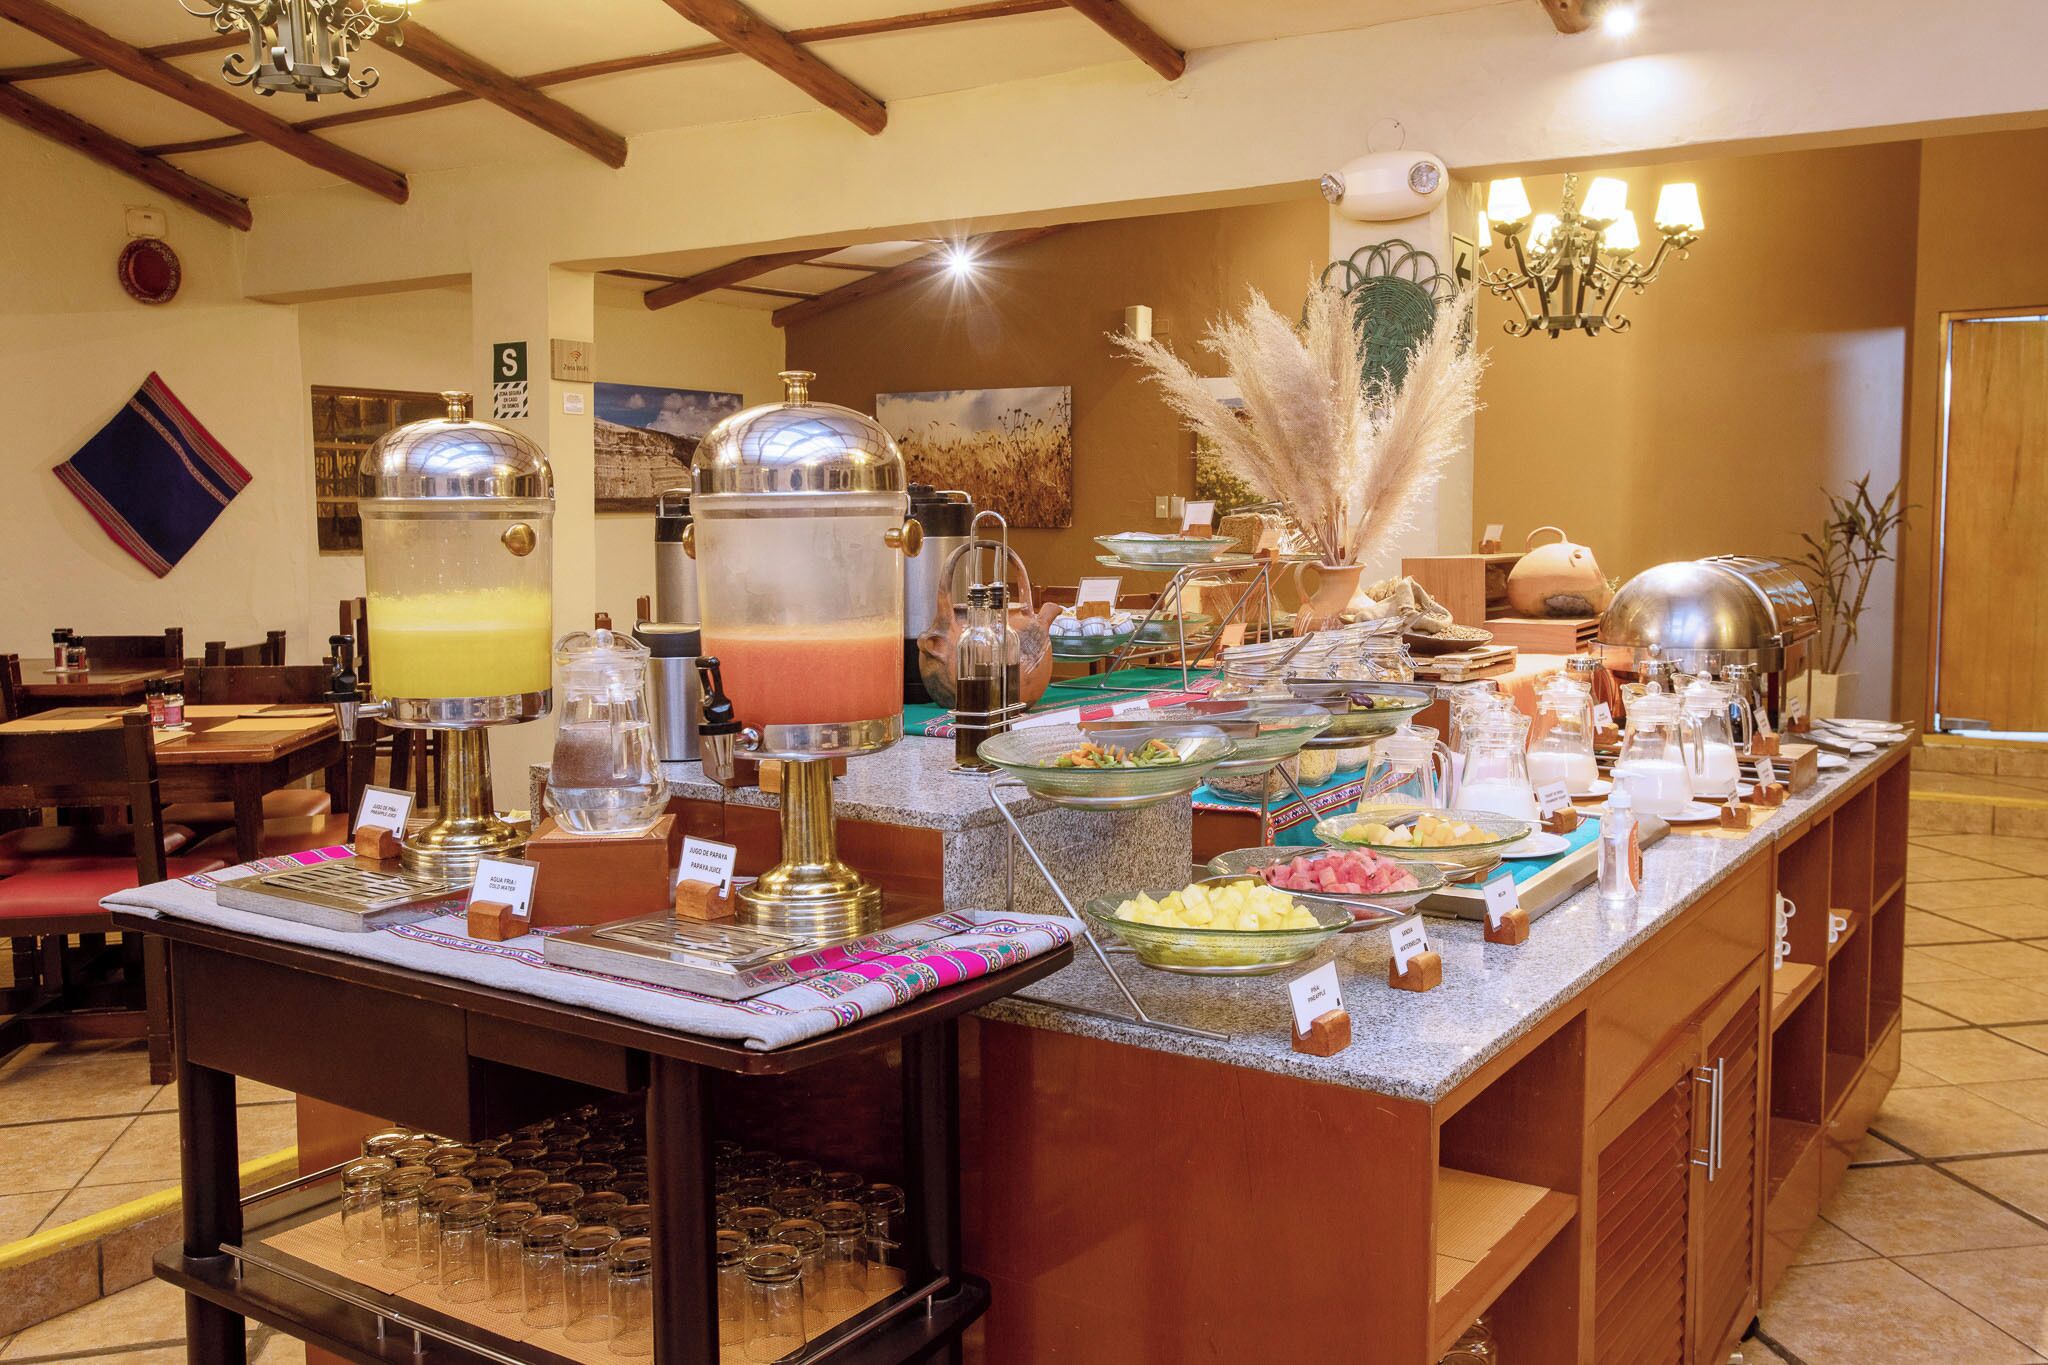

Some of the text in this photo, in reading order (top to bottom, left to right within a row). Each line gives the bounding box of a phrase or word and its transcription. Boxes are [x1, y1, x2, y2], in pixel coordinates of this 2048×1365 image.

[502, 348, 518, 377] S
[689, 847, 728, 861] JUGO DE PAPAYA
[690, 861, 722, 875] PAPAYA JUICE
